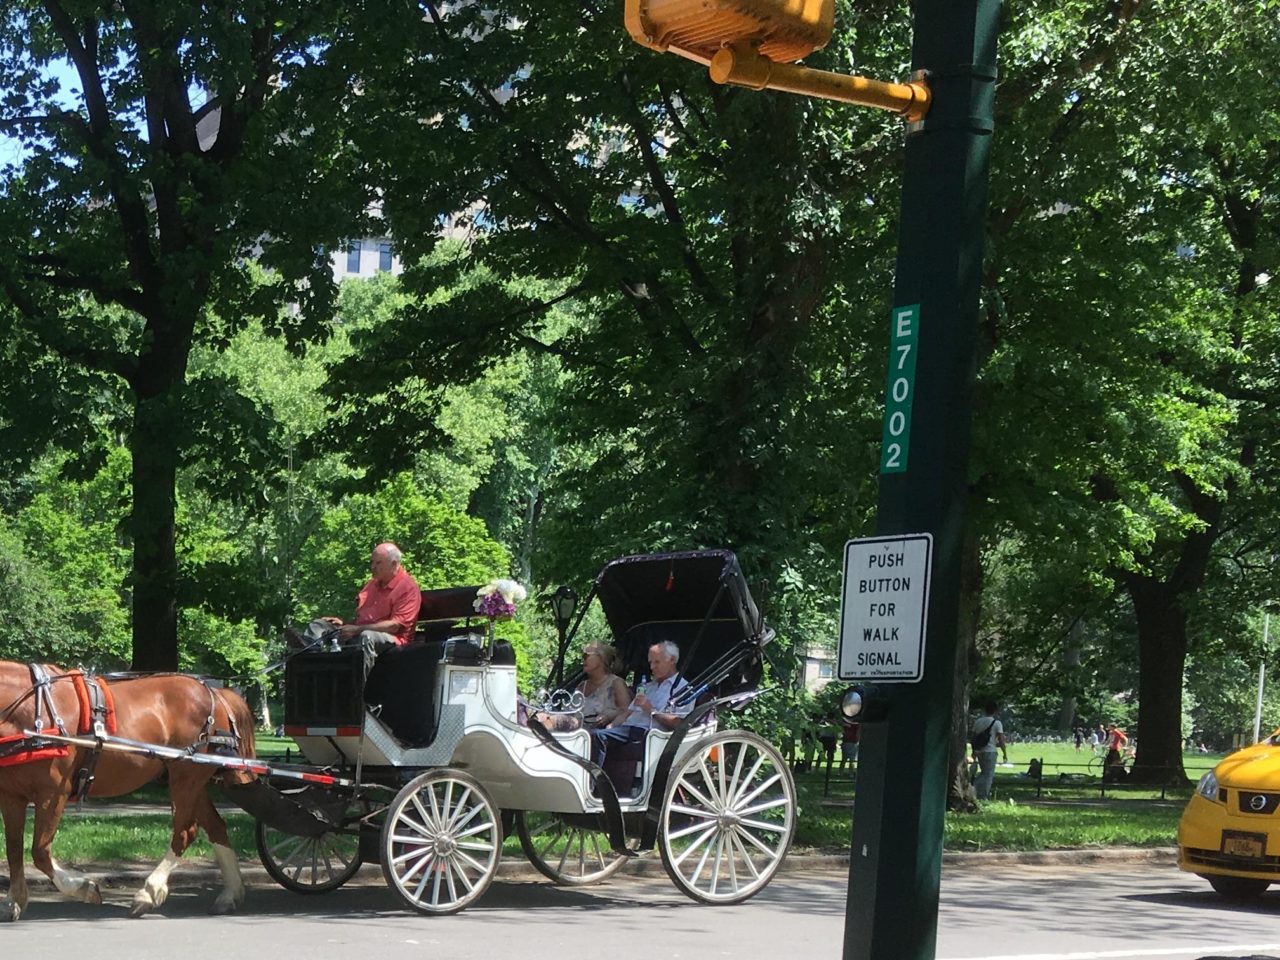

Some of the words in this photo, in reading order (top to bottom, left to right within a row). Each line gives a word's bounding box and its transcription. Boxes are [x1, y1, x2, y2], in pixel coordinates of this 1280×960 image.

[885, 310, 913, 468] E7002
[868, 553, 904, 568] PUSH
[859, 577, 911, 594] BUTTON
[869, 603, 896, 617] FOR
[863, 627, 900, 642] WALK
[857, 652, 902, 666] SIGNAL
